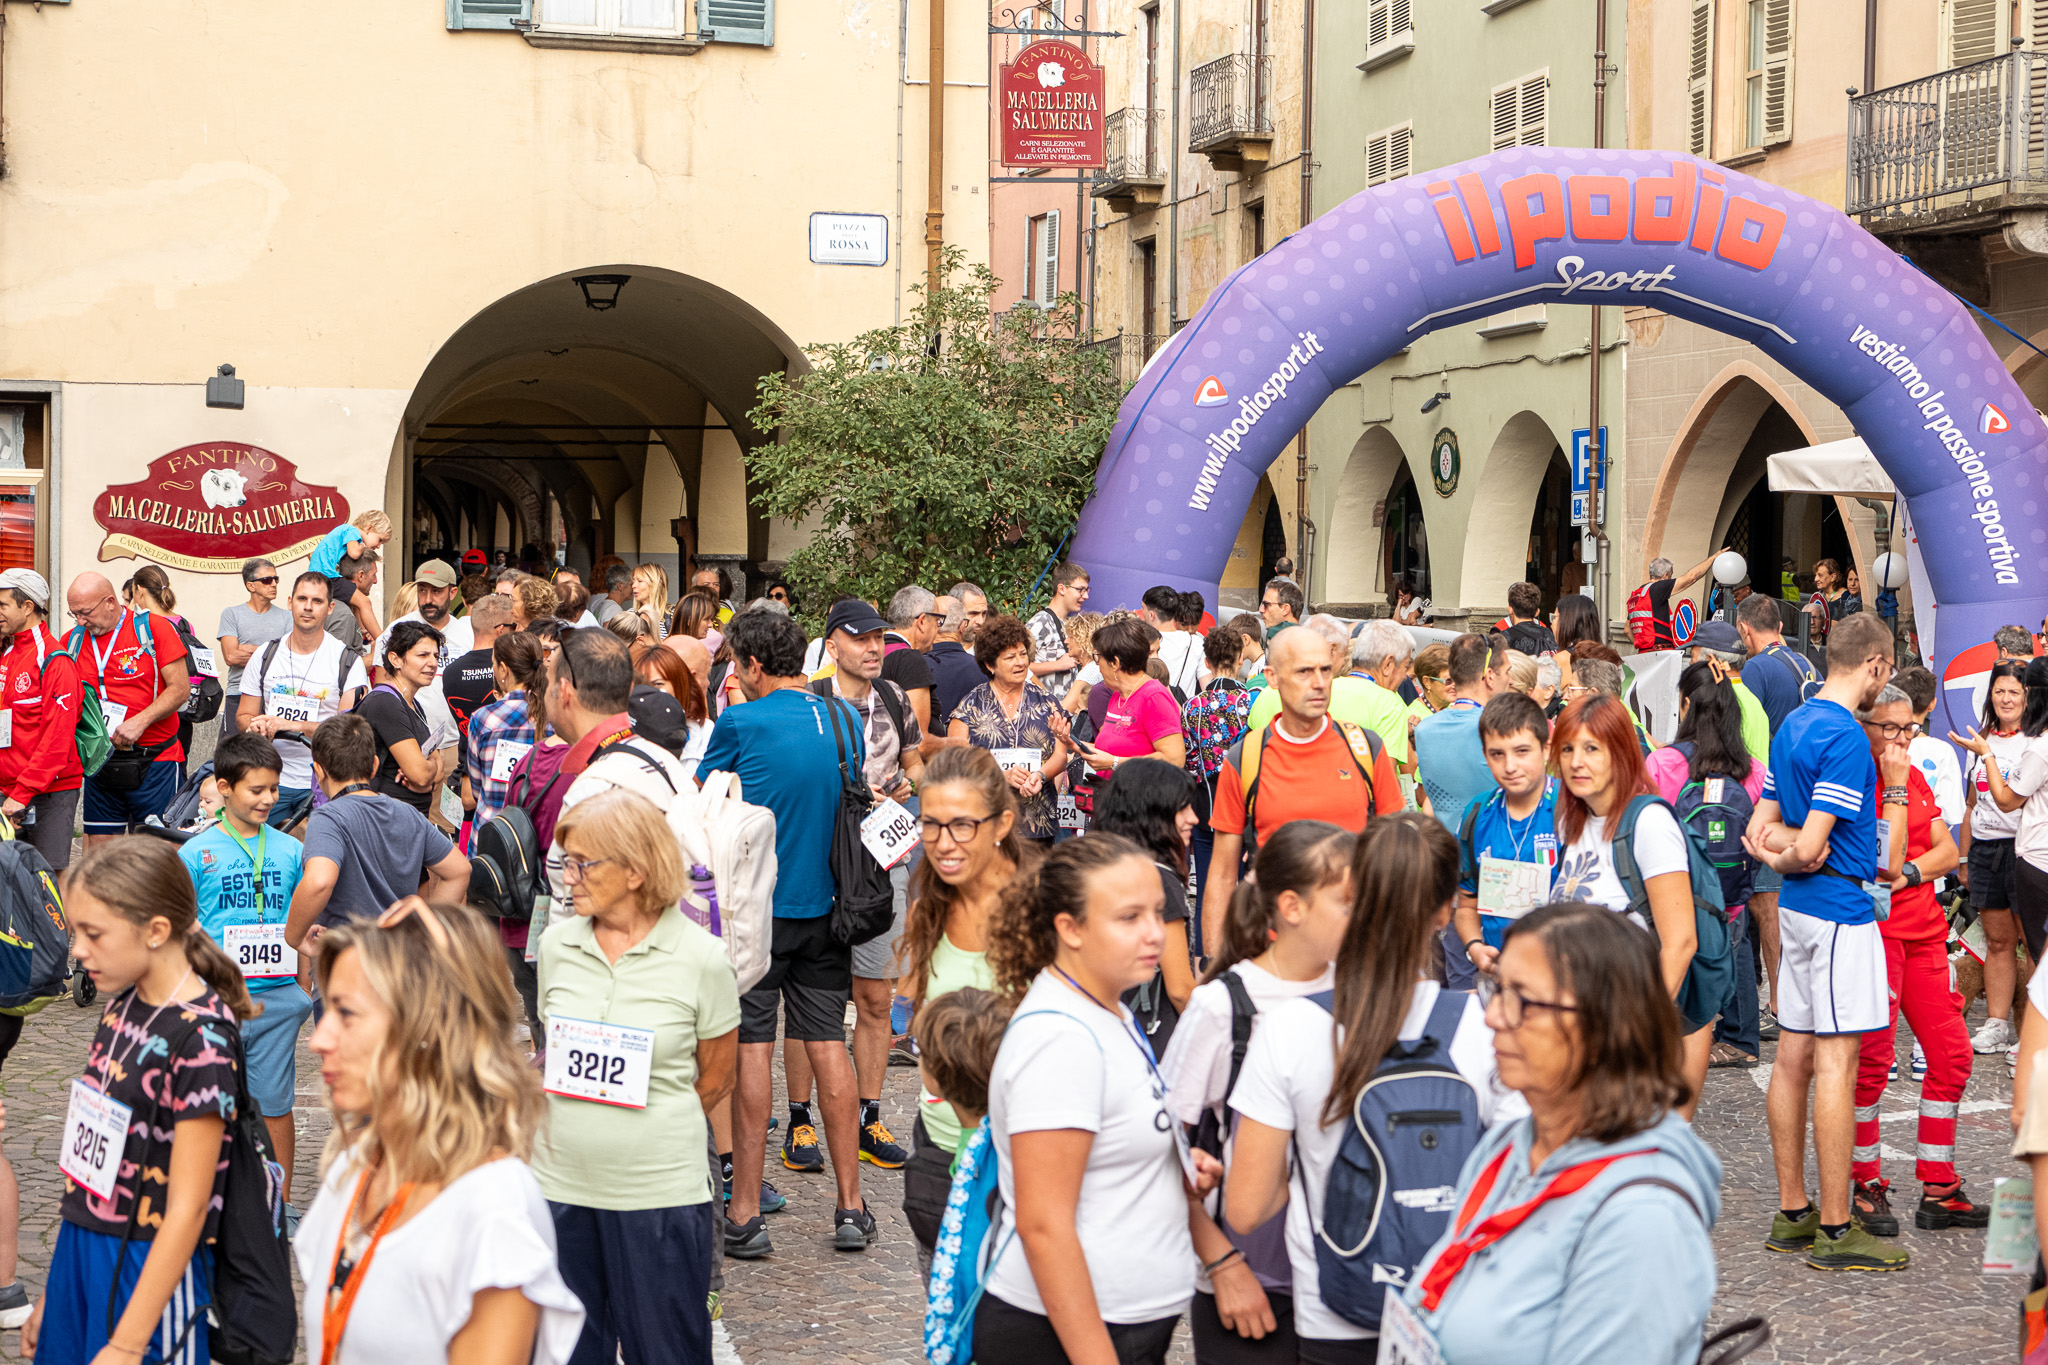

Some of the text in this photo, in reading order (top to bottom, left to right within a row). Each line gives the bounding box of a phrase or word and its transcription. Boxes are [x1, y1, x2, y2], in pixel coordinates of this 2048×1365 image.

[1021, 46, 1084, 70] FANTINO
[1007, 91, 1098, 111] MACELLERIA
[1012, 111, 1094, 131] SALUMERIA
[1041, 140, 1086, 148] SELEZIONATE
[832, 223, 866, 231] PIAZZA
[829, 239, 869, 250] ROSSA
[1556, 254, 1678, 297] Sport
[1188, 330, 1325, 512] www.ilpodiosport.it
[167, 449, 278, 474] FANTINO
[1847, 323, 2021, 585] vestiamo la passione sportiva
[108, 495, 336, 536] MACELLERIA-SALUMERIA
[119, 536, 144, 554] CARNI
[142, 544, 192, 568] SELEZIONATE
[192, 560, 199, 569] E
[199, 560, 242, 571] GARANTITE
[280, 552, 289, 561] IN
[461, 667, 494, 676] TSUNAM
[276, 706, 309, 722] 2624
[880, 814, 914, 848] 3192
[227, 858, 247, 870] che
[45, 902, 65, 931] CMP
[239, 943, 282, 965] 3149
[621, 1032, 649, 1043] BUSCA
[567, 1049, 626, 1086] 3212
[73, 1121, 110, 1171] 3215
